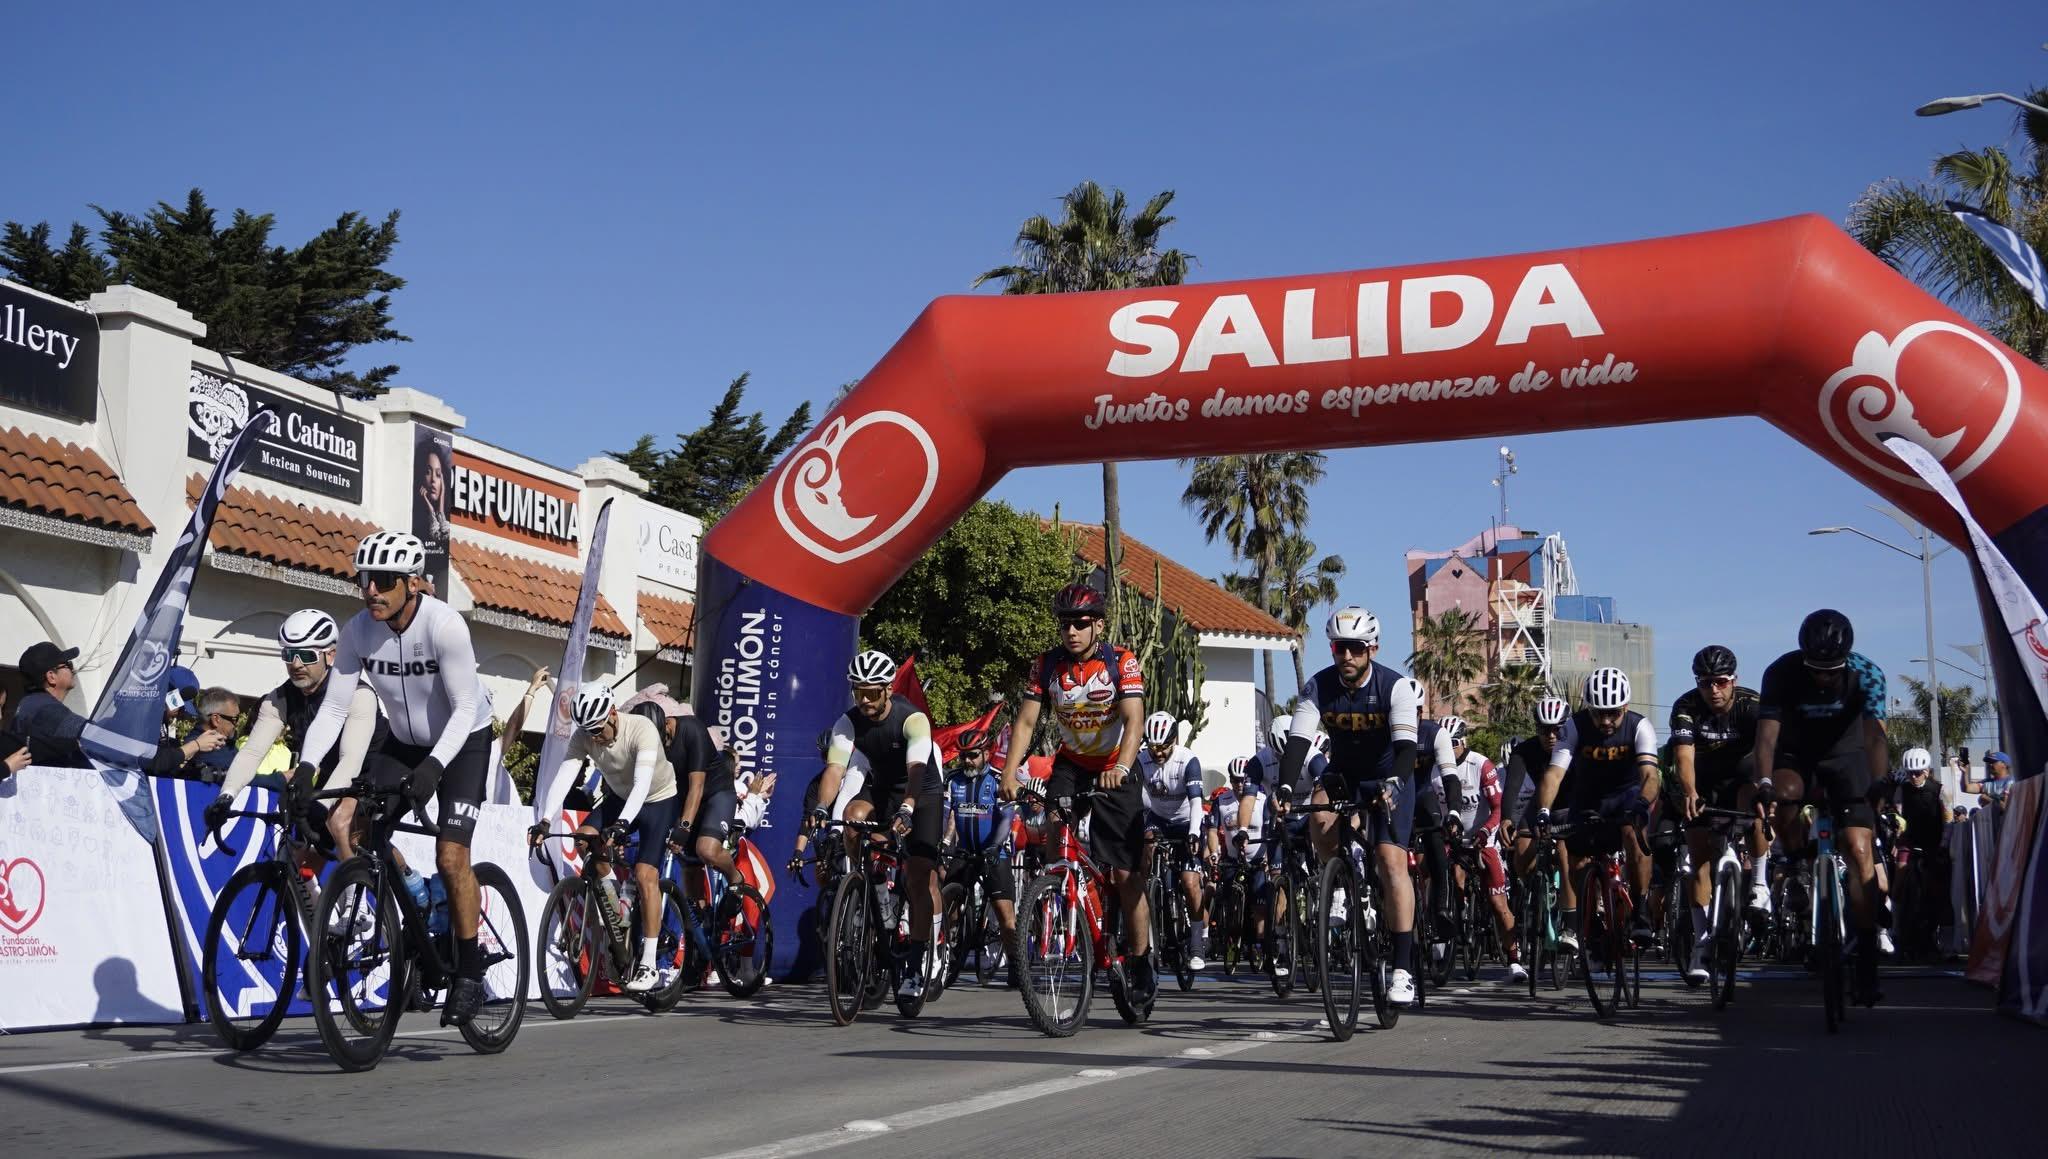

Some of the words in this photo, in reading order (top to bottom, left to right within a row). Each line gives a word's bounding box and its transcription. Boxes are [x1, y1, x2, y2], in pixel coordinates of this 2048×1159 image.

[0, 304, 80, 369] llery
[1106, 263, 1604, 378] SALIDA
[1084, 391, 1190, 430] Juntos
[1201, 387, 1310, 418] damos
[1321, 375, 1500, 417] esperanza
[1509, 361, 1553, 394] de
[1560, 353, 1639, 388] vida
[257, 401, 282, 437] a
[287, 412, 357, 461] Catrina
[261, 450, 300, 473] Mexican
[306, 464, 351, 488] Souvenirs
[658, 524, 693, 561] Casa
[361, 657, 440, 676] VIEJOS
[767, 613, 783, 680] cáncer
[714, 658, 735, 746] dación
[764, 692, 777, 720] sin
[761, 732, 774, 772] iñez
[2, 935, 40, 945] Fundación
